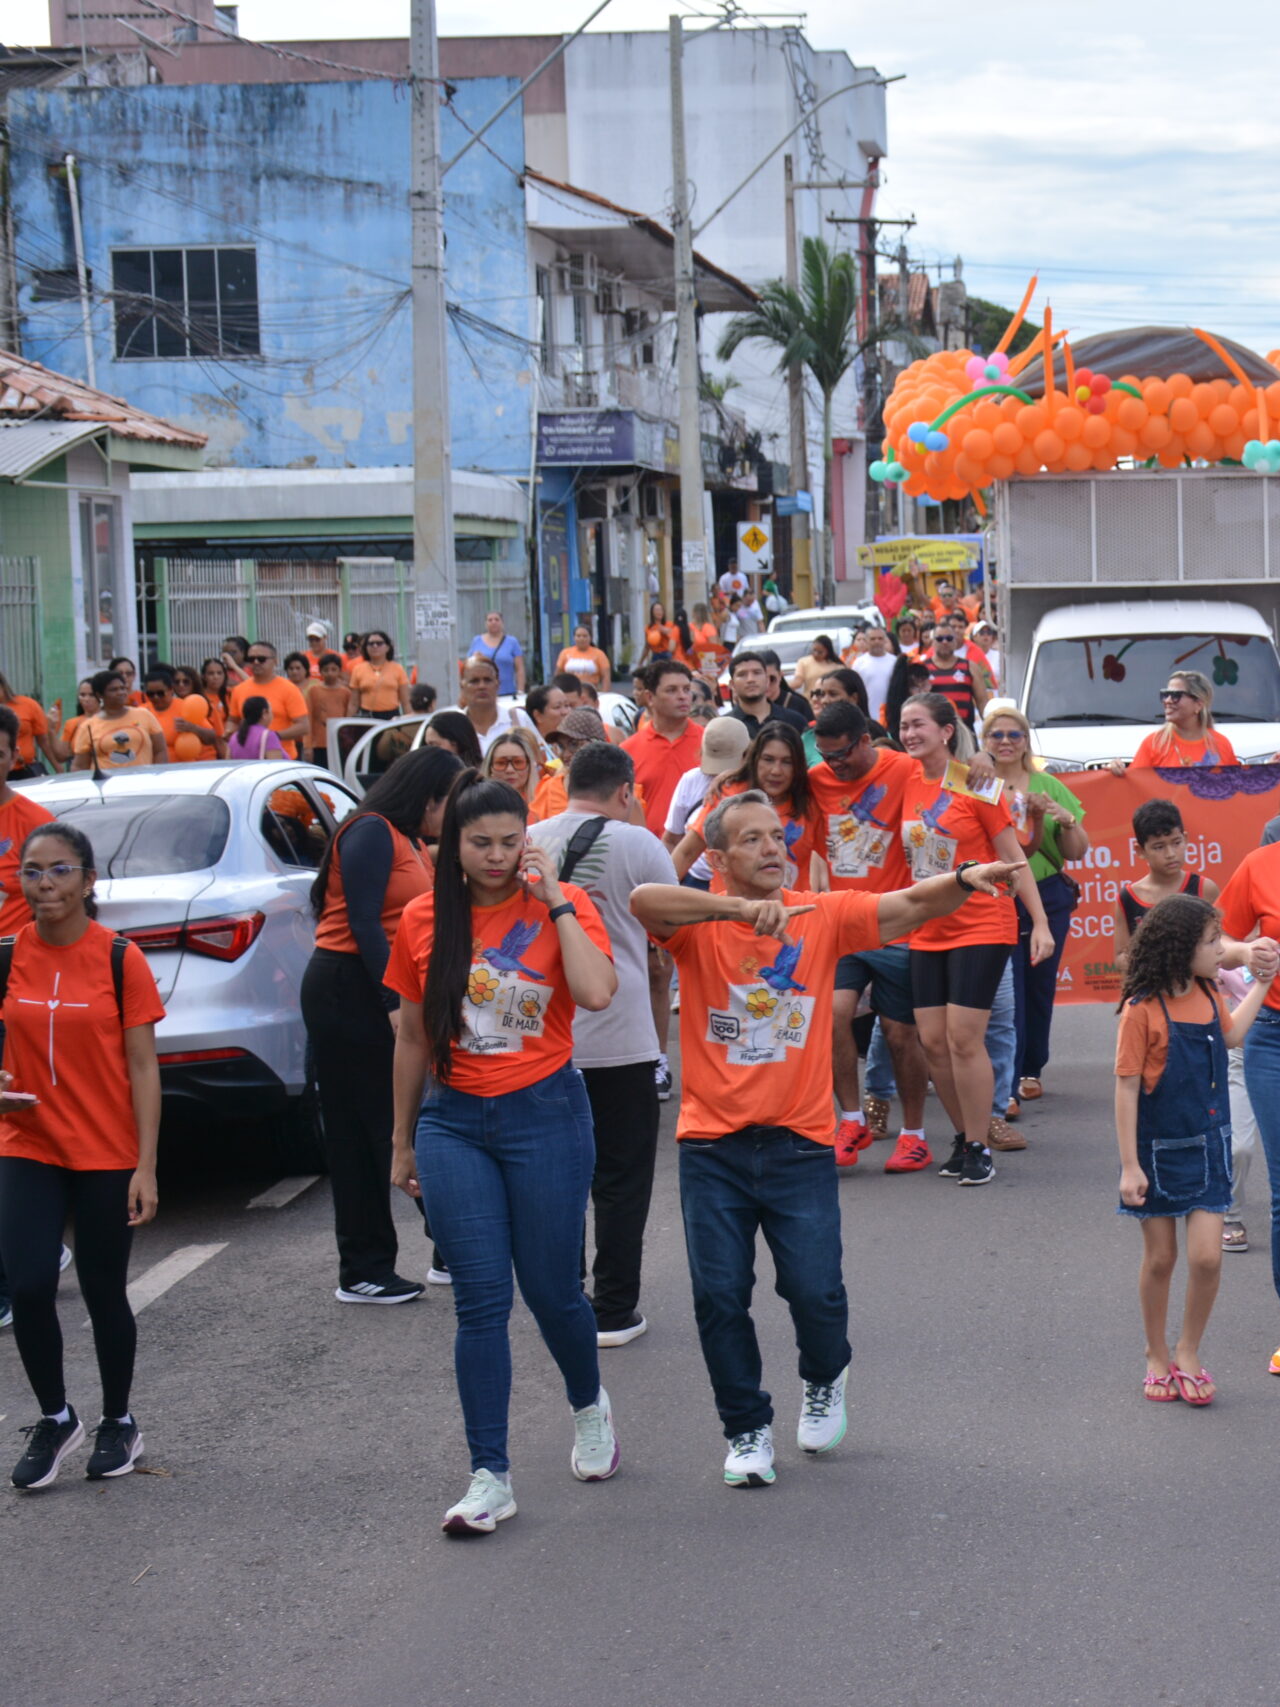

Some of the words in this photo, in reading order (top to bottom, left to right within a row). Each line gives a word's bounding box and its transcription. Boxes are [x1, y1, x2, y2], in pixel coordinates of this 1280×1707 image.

[502, 1014, 513, 1028] DE
[515, 1018, 540, 1032] MAIO
[714, 1025, 736, 1034] 100
